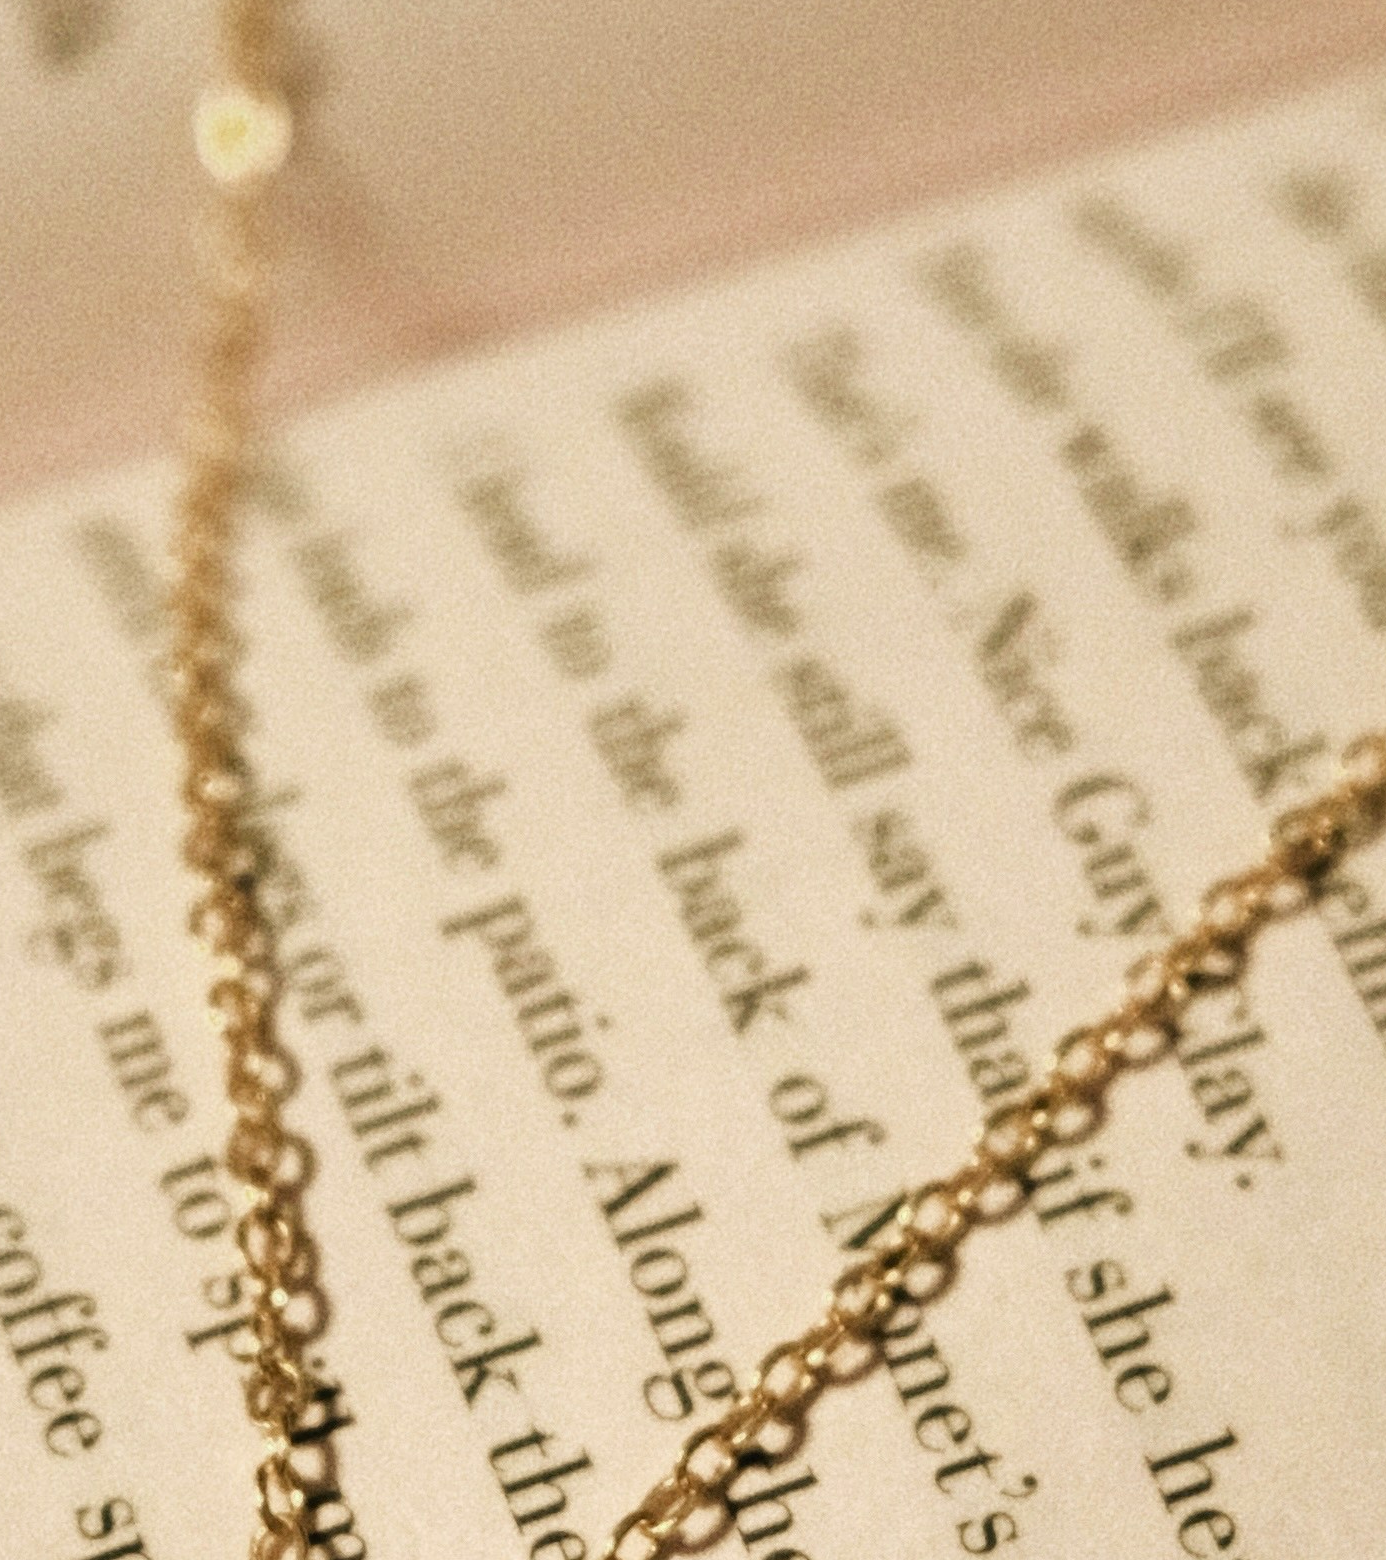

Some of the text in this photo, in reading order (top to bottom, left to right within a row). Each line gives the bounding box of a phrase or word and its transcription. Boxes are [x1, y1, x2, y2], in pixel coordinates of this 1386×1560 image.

[1169, 608, 1355, 803] back
[854, 808, 957, 930] say
[1037, 762, 1182, 952] Guy
[282, 938, 373, 1038] or
[656, 829, 811, 1037] back
[769, 1073, 887, 1161] of
[920, 956, 1048, 1108] tha
[91, 1008, 199, 1140] me
[151, 1149, 250, 1248] to
[322, 1040, 450, 1176] tilt
[438, 894, 612, 1129] patio.
[577, 1137, 742, 1430] Along
[1015, 1157, 1139, 1243] if
[385, 1175, 544, 1408] back
[1066, 1260, 1176, 1407] she
